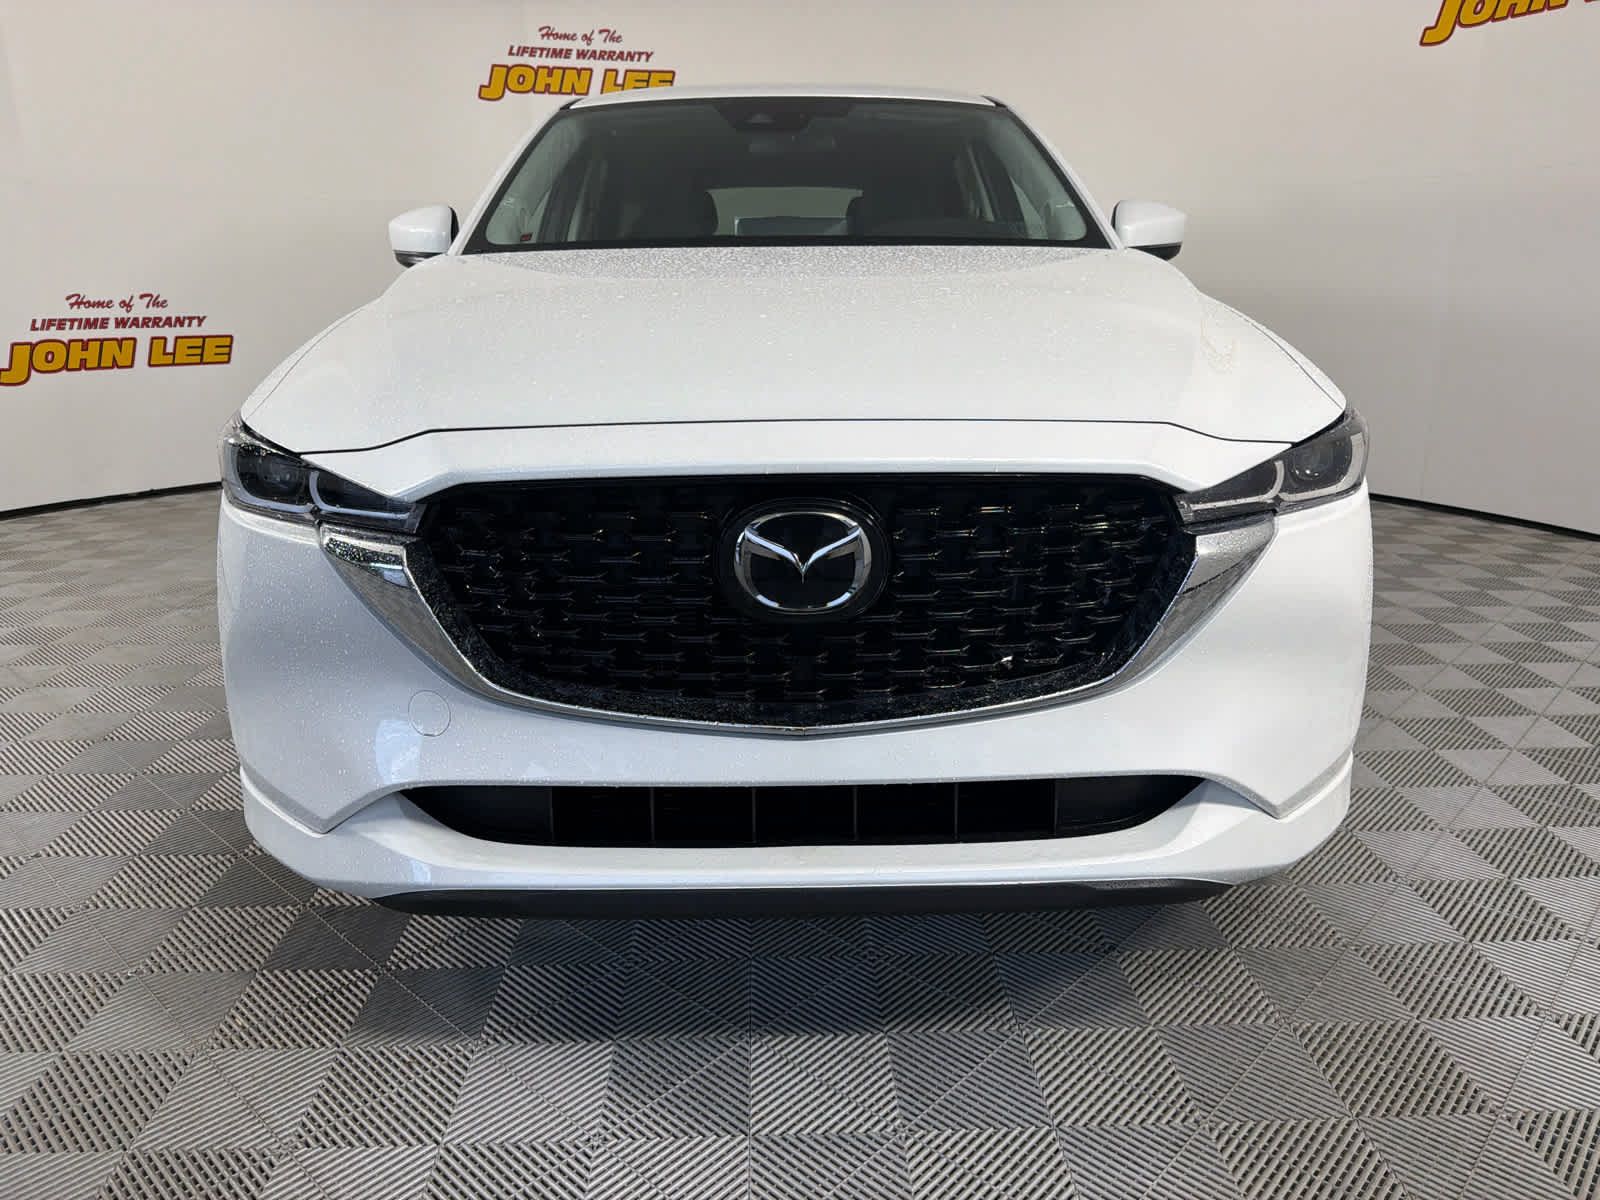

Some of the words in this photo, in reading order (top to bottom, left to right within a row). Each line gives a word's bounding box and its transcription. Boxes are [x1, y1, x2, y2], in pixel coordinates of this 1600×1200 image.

[538, 25, 577, 41] Home
[581, 29, 595, 46] of
[598, 28, 622, 44] The
[508, 45, 572, 60] LIFETIME
[575, 48, 653, 63] WARRANTY
[478, 64, 593, 101] JOHN
[65, 293, 114, 310] Home
[118, 296, 134, 313] of
[139, 293, 168, 309] The
[30, 317, 109, 331] LIFETIME
[114, 315, 207, 329] WARRANTY
[0, 337, 137, 386] JOHN
[148, 335, 233, 367] LEE
